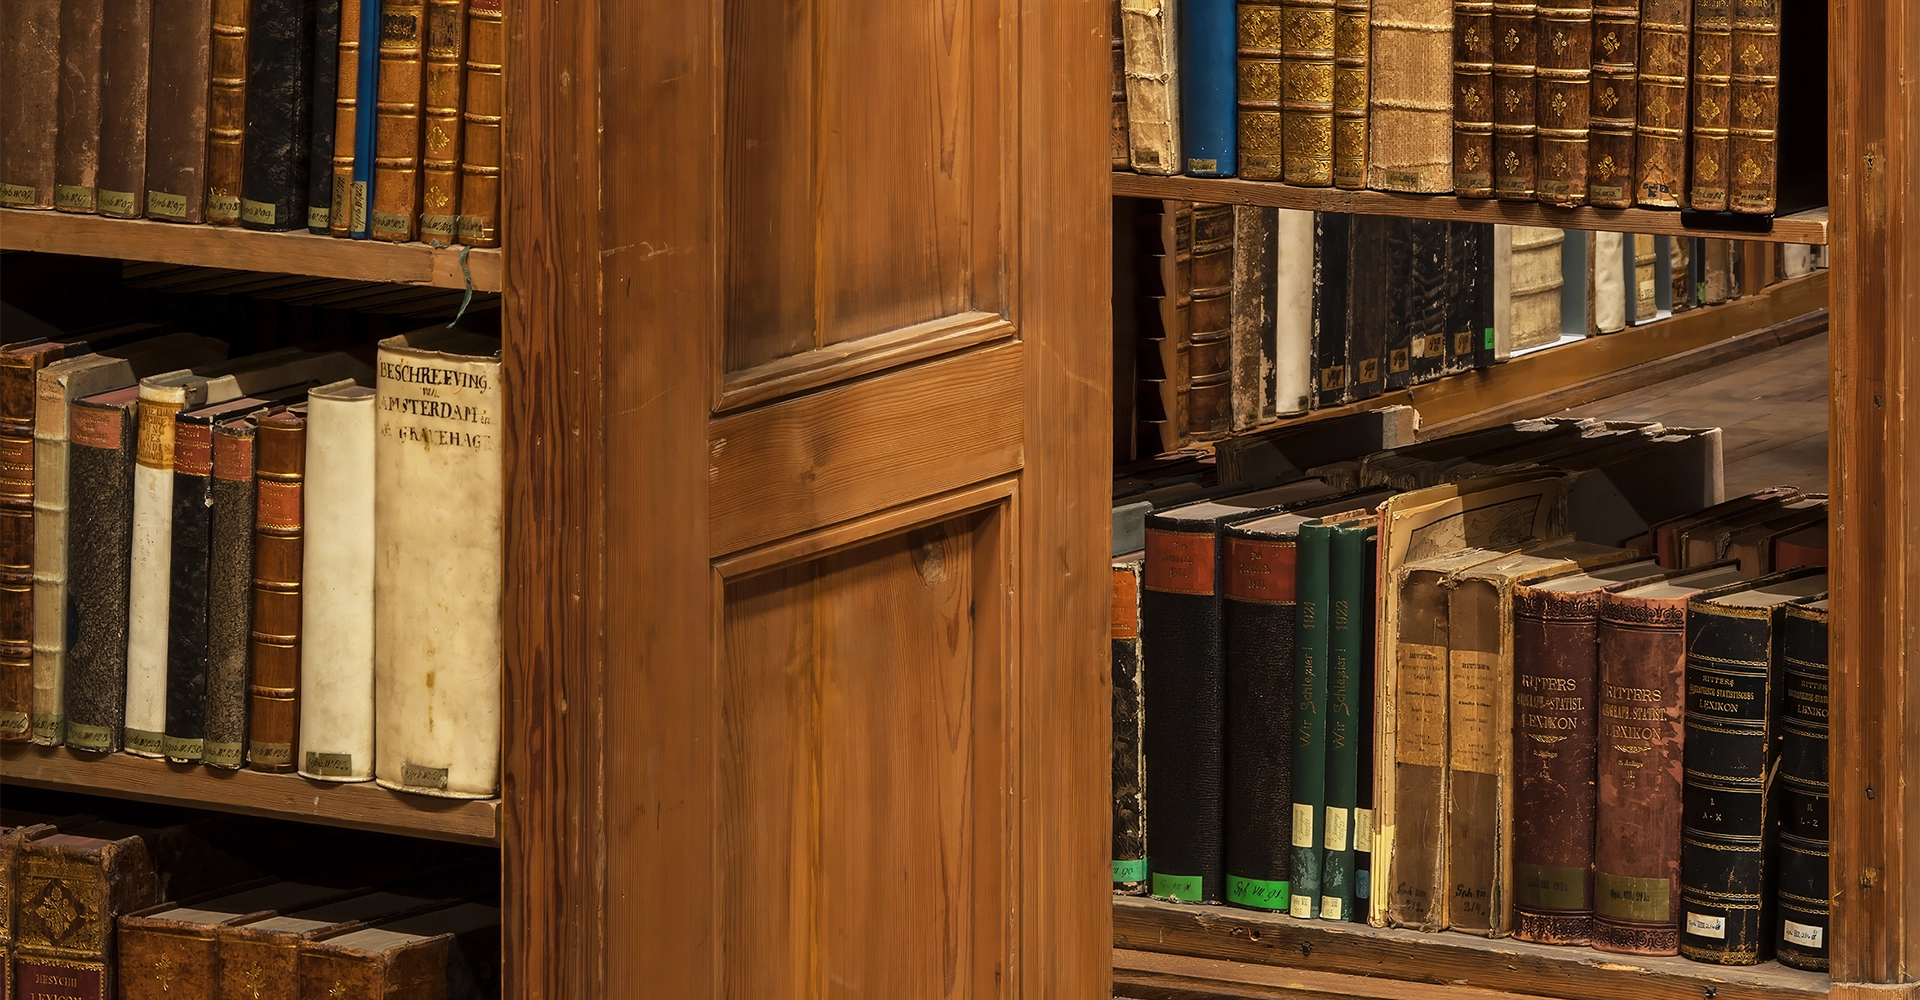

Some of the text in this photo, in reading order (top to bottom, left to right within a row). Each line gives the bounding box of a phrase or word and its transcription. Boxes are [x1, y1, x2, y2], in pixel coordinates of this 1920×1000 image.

[1303, 601, 1316, 629] 1921
[1336, 600, 1348, 630] 1922
[1522, 674, 1577, 691] RITTERS
[1702, 675, 1735, 687] RITTERS
[1605, 684, 1662, 702] RITTERS
[1699, 699, 1739, 712] LEXIKON
[1521, 713, 1578, 730] LEXIKON
[1299, 720, 1312, 748] Wir
[1332, 722, 1345, 750] Wir
[1605, 723, 1661, 740] LEXIKON
